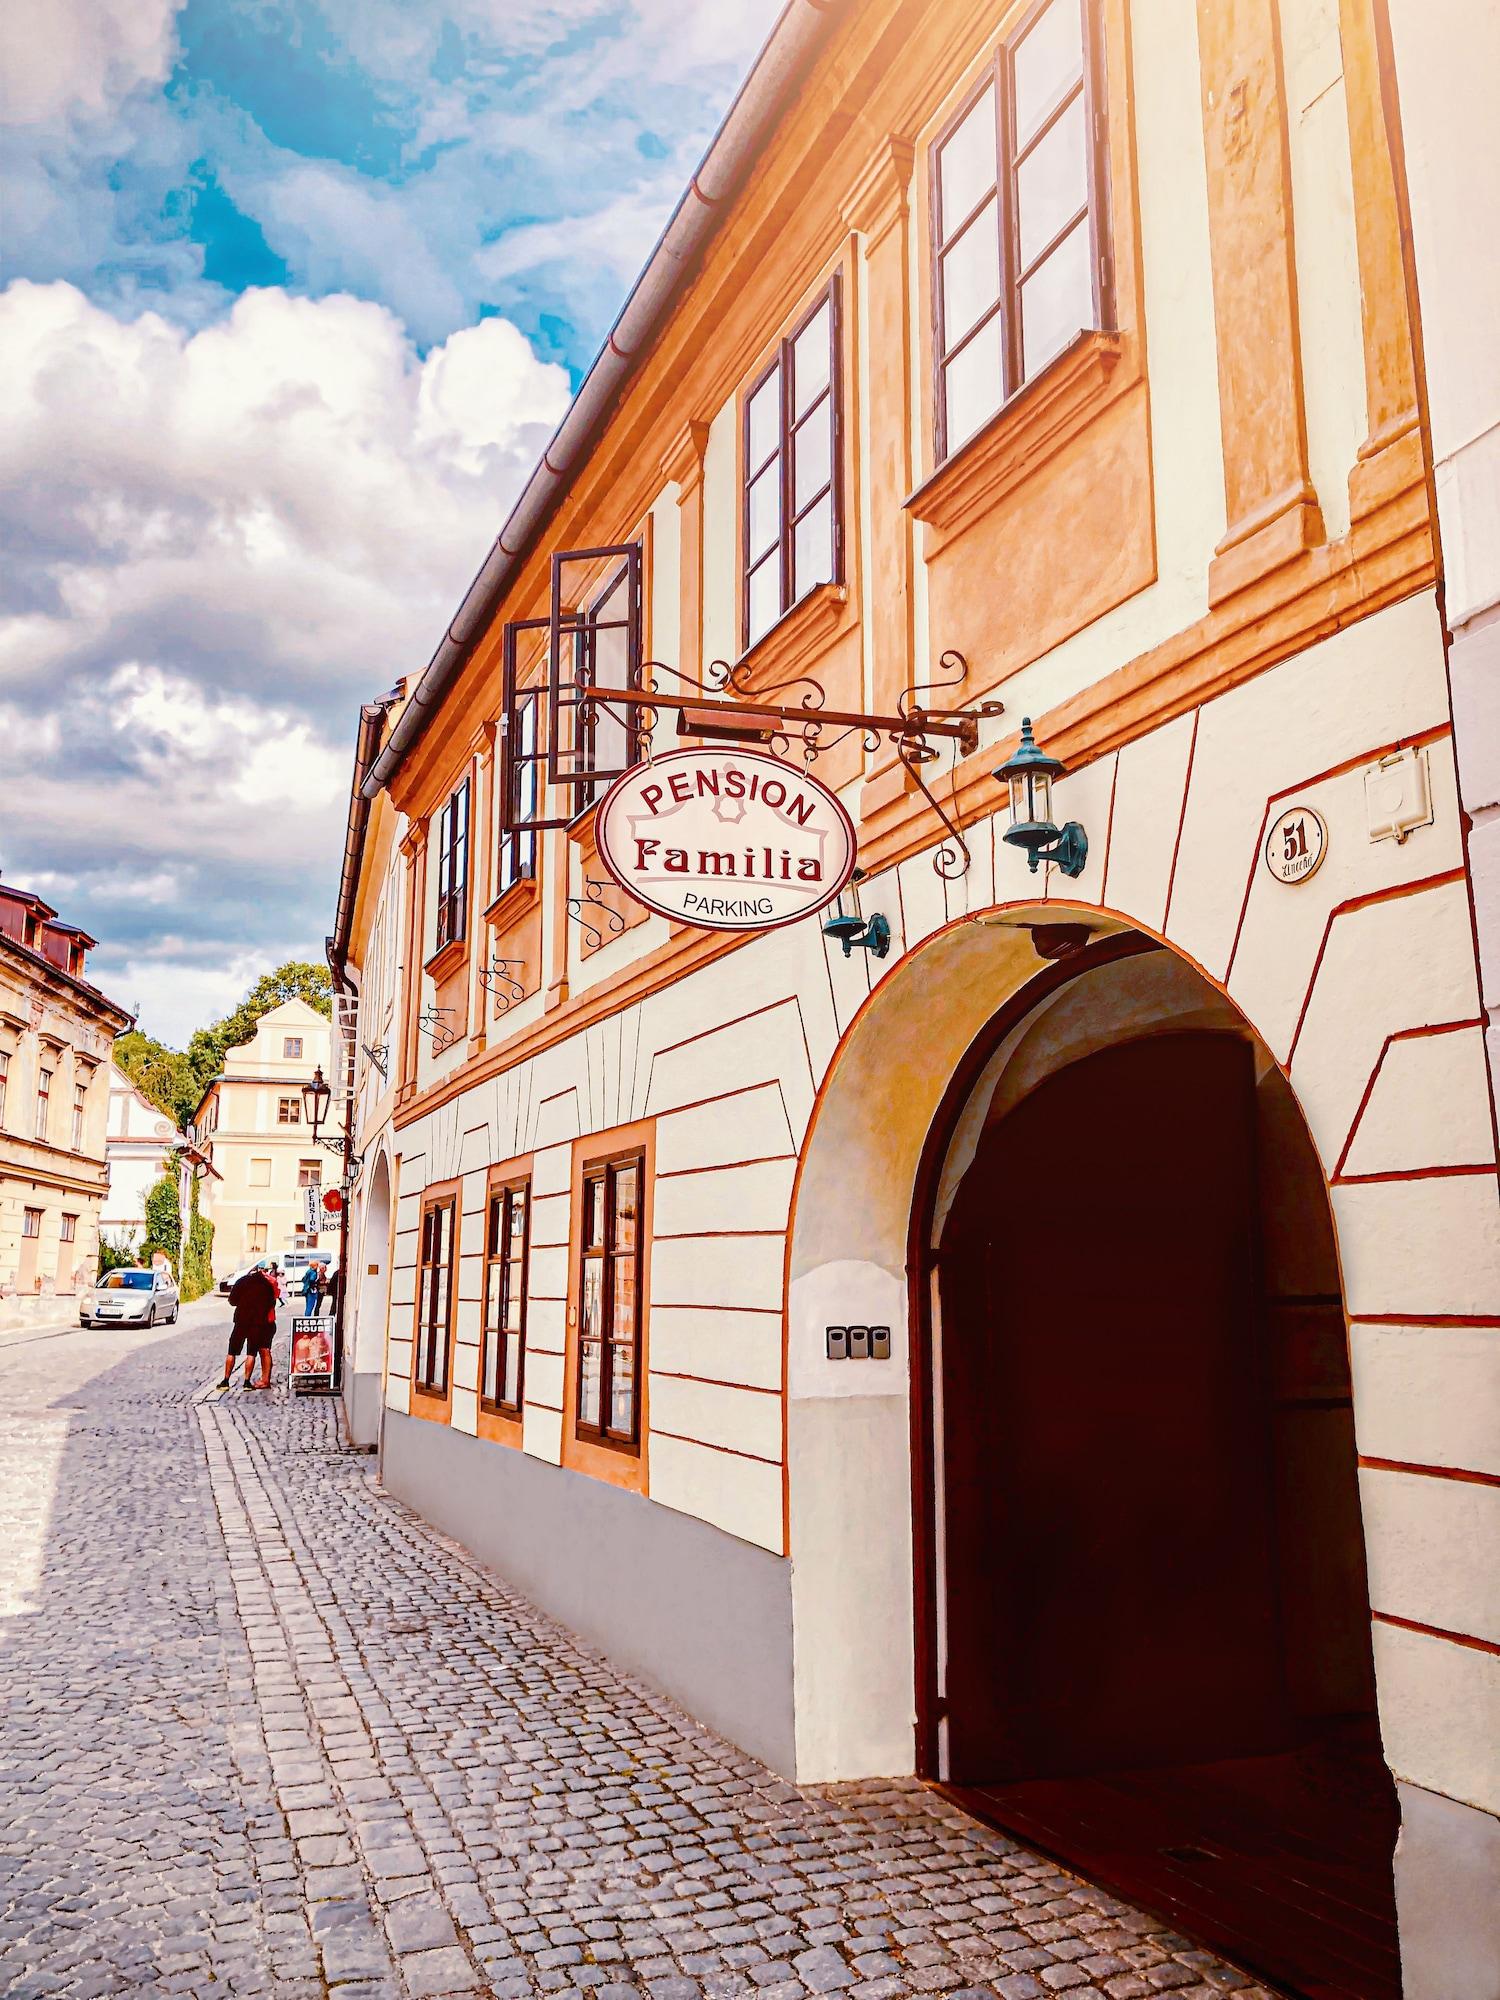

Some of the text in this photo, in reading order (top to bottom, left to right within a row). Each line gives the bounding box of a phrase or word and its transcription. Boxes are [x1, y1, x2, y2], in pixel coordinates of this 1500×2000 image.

[640, 769, 816, 826] PENSION
[633, 838, 823, 882] Familia
[1283, 817, 1309, 861] 51
[683, 892, 773, 917] PARKING
[308, 1189, 316, 1232] PENSION
[322, 1222, 348, 1232] ROS
